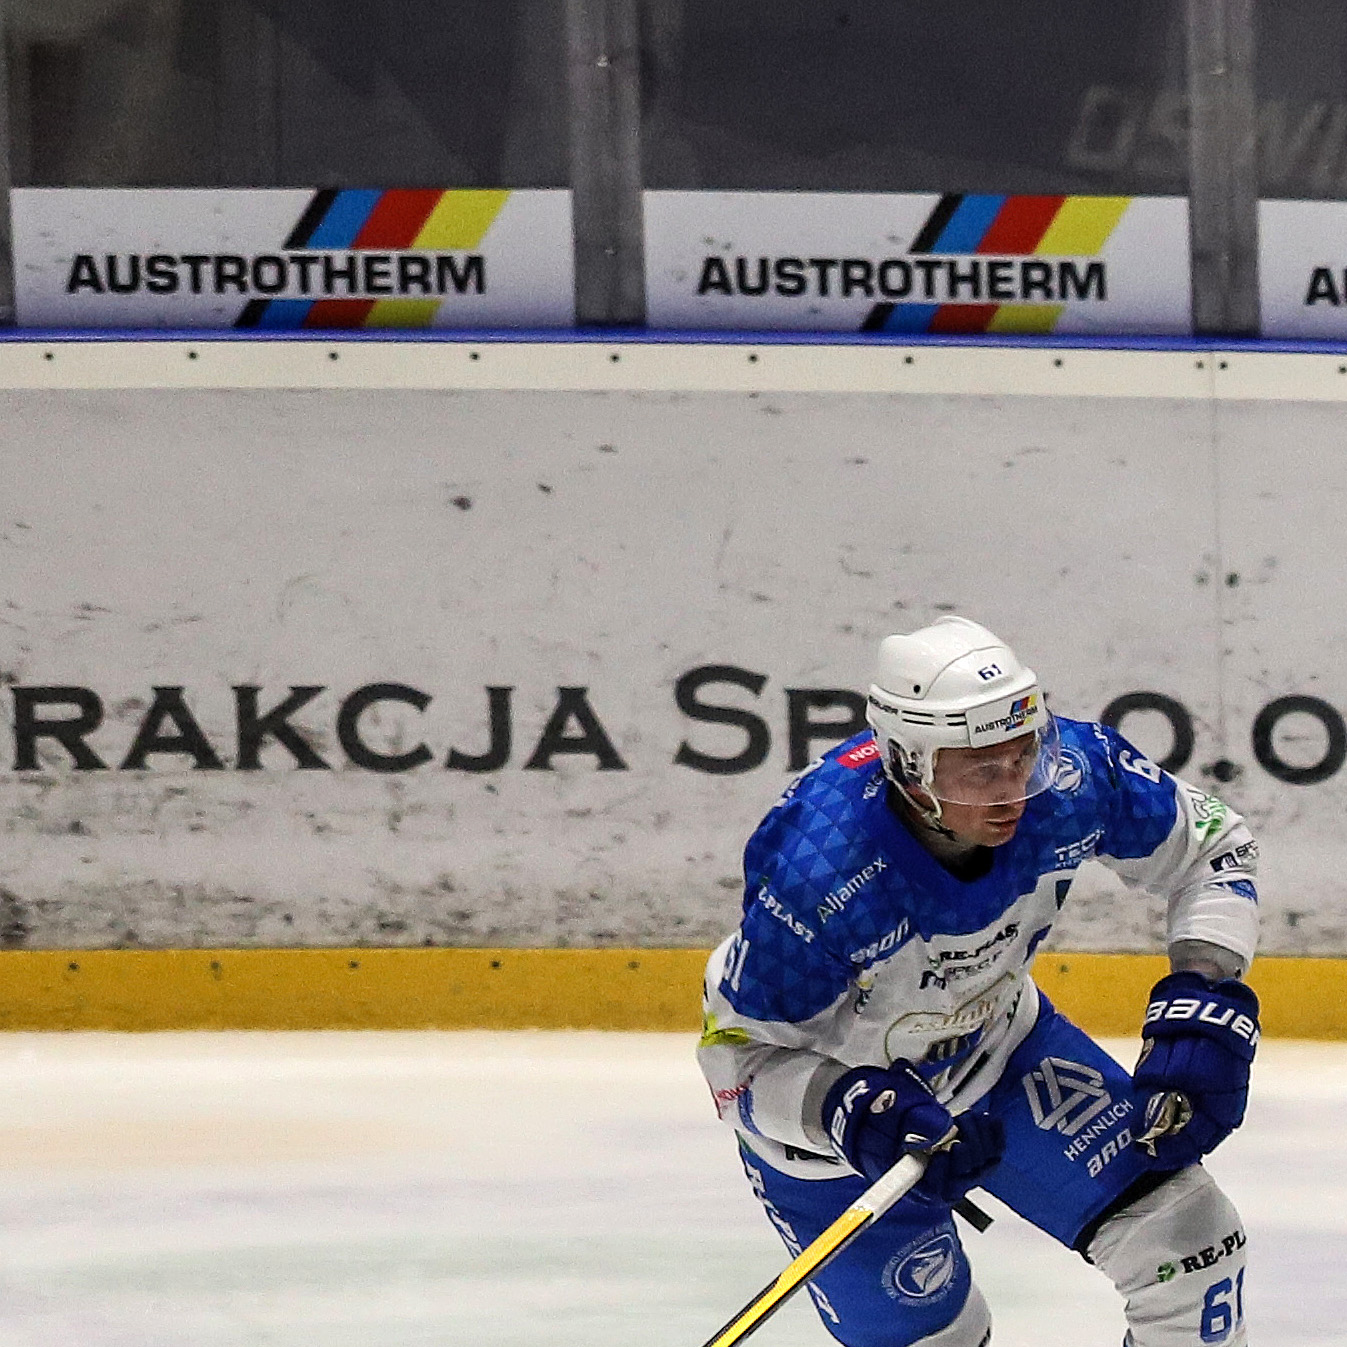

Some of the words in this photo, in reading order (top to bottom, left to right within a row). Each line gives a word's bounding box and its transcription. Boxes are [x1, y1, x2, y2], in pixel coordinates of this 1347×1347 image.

[65, 254, 487, 296] AUSTROTHERM
[696, 256, 1107, 301] AUSTROTHERM
[978, 663, 1002, 681] 61
[10, 682, 628, 775] RAKCJA
[974, 705, 1039, 734] AUSTROTHERM
[816, 857, 887, 924] Aljamex
[1062, 1098, 1134, 1162] HENNLICH
[1199, 1264, 1246, 1344] 61
